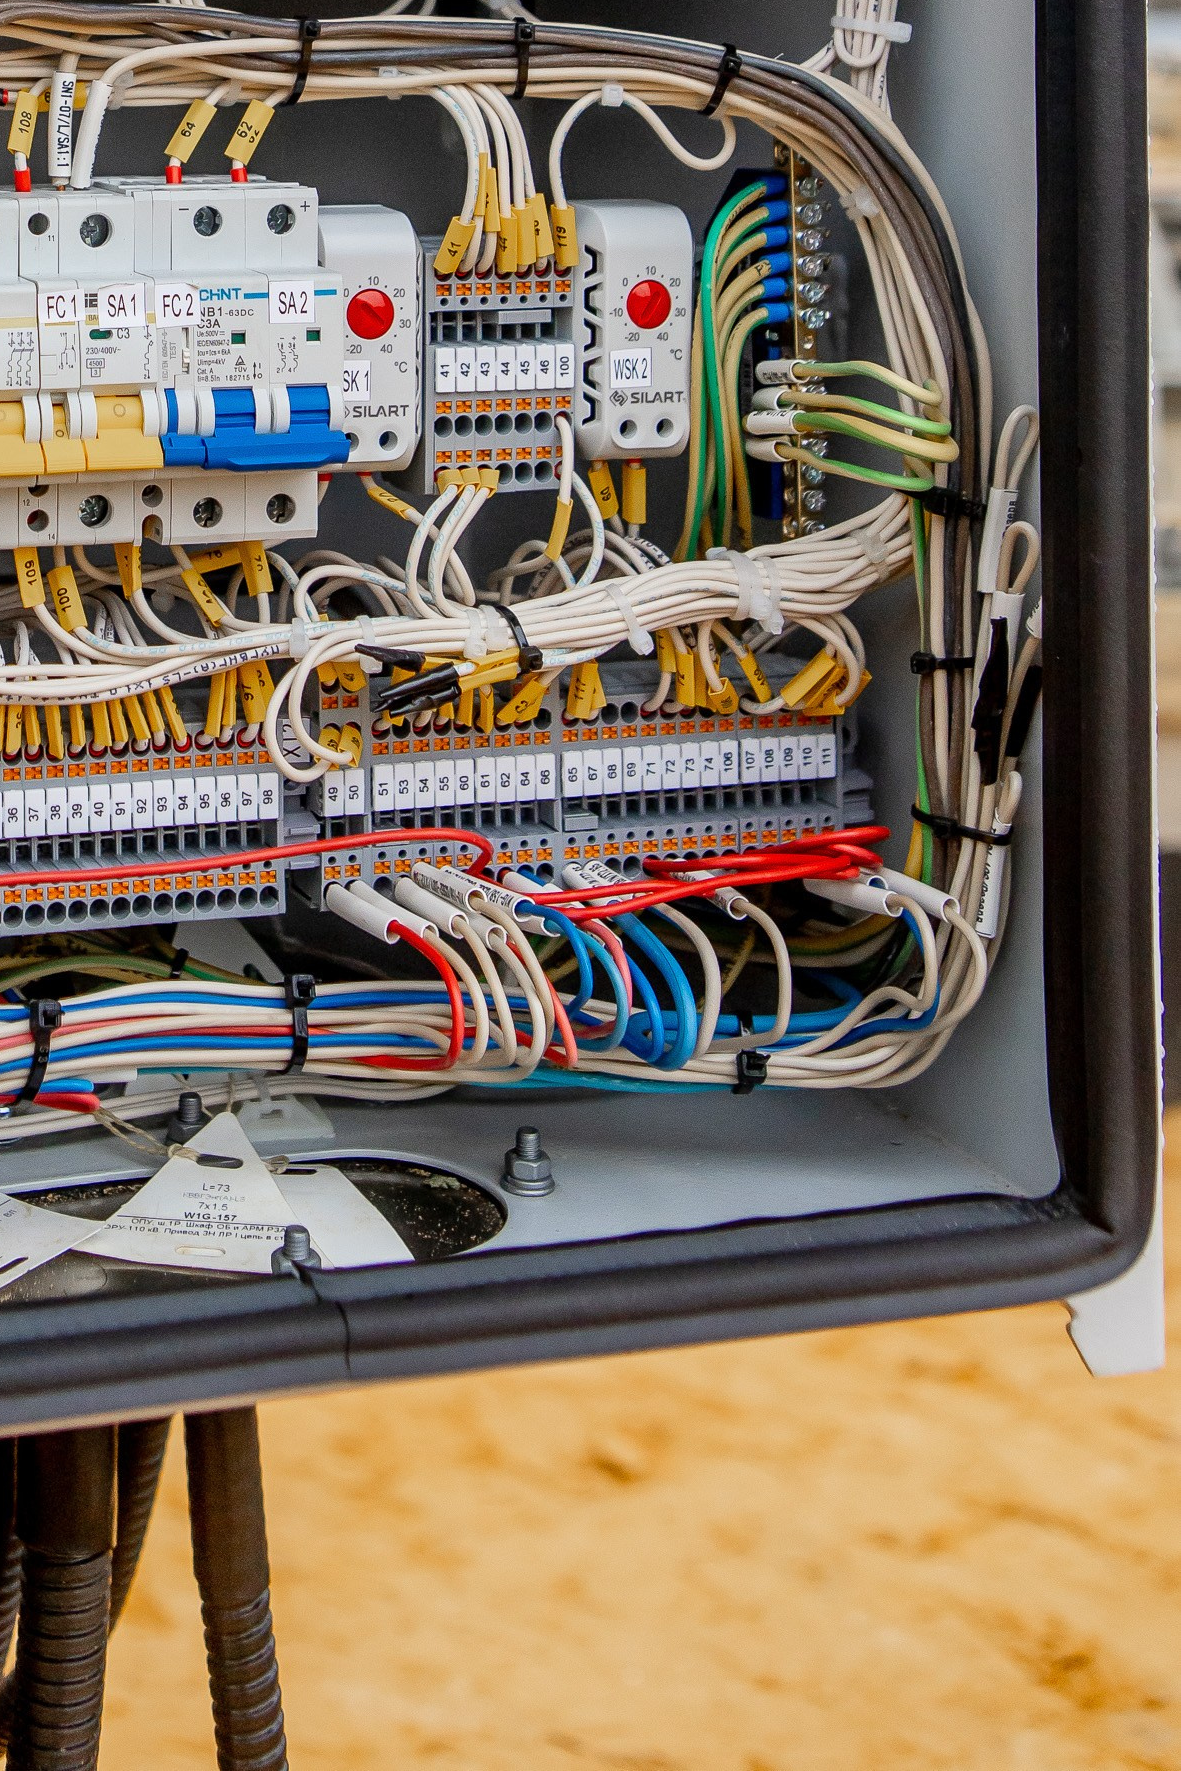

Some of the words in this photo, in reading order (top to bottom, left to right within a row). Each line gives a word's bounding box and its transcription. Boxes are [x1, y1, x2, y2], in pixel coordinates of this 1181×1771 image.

[19, 111, 32, 134] 108
[56, 81, 75, 167] SN1-07/L/SA1:1
[181, 122, 196, 138] 64
[236, 120, 253, 138] 62
[448, 241, 461, 257] 41
[646, 267, 657, 275] 10
[368, 277, 379, 286] 10
[623, 278, 628, 287] 0
[669, 278, 680, 287] 20
[394, 289, 405, 297] 20
[47, 295, 68, 318] FC
[71, 296, 76, 316] 1
[108, 294, 127, 317] SA
[131, 295, 136, 316] 1
[163, 295, 183, 316] FC
[186, 295, 194, 316] 2
[279, 291, 297, 314] SA
[300, 291, 307, 314] 2
[609, 308, 623, 317] -10
[675, 308, 686, 316] 30
[399, 319, 411, 328] 30
[117, 328, 130, 339] C3
[625, 333, 639, 342] -20
[657, 332, 669, 341] 40
[346, 345, 362, 354] -20
[380, 344, 392, 353] 40
[669, 349, 683, 360] °C
[394, 361, 408, 374] °C
[440, 364, 450, 378] 41
[460, 362, 471, 378] 42
[480, 361, 491, 377] 43
[500, 361, 511, 376] 44
[519, 360, 530, 376] 45
[539, 359, 550, 375] 46
[559, 356, 570, 378] 100
[614, 360, 638, 380] WSK
[641, 359, 648, 379] 2
[343, 371, 359, 391] SK
[364, 371, 369, 390] 1
[631, 392, 684, 404] SILART
[353, 405, 409, 418] SILART
[24, 559, 38, 586] 109
[57, 587, 72, 613] 100
[704, 757, 714, 772] 74
[723, 751, 733, 773] 106
[764, 748, 775, 770] 108
[822, 747, 832, 766] 111
[520, 771, 530, 787] 64
[567, 767, 578, 783] 65
[607, 763, 617, 780] 68
[378, 782, 389, 796] 51
[418, 778, 429, 793] 54
[459, 775, 469, 791] 60
[262, 789, 273, 805] 98
[327, 786, 339, 802] 49
[50, 804, 61, 821] 38
[114, 801, 126, 816] 91
[156, 796, 168, 813] 93
[7, 807, 19, 824] 36
[202, 1183, 230, 1192] L=73
[198, 1202, 228, 1211] 7x1.5
[184, 1212, 237, 1221] W1G-157
